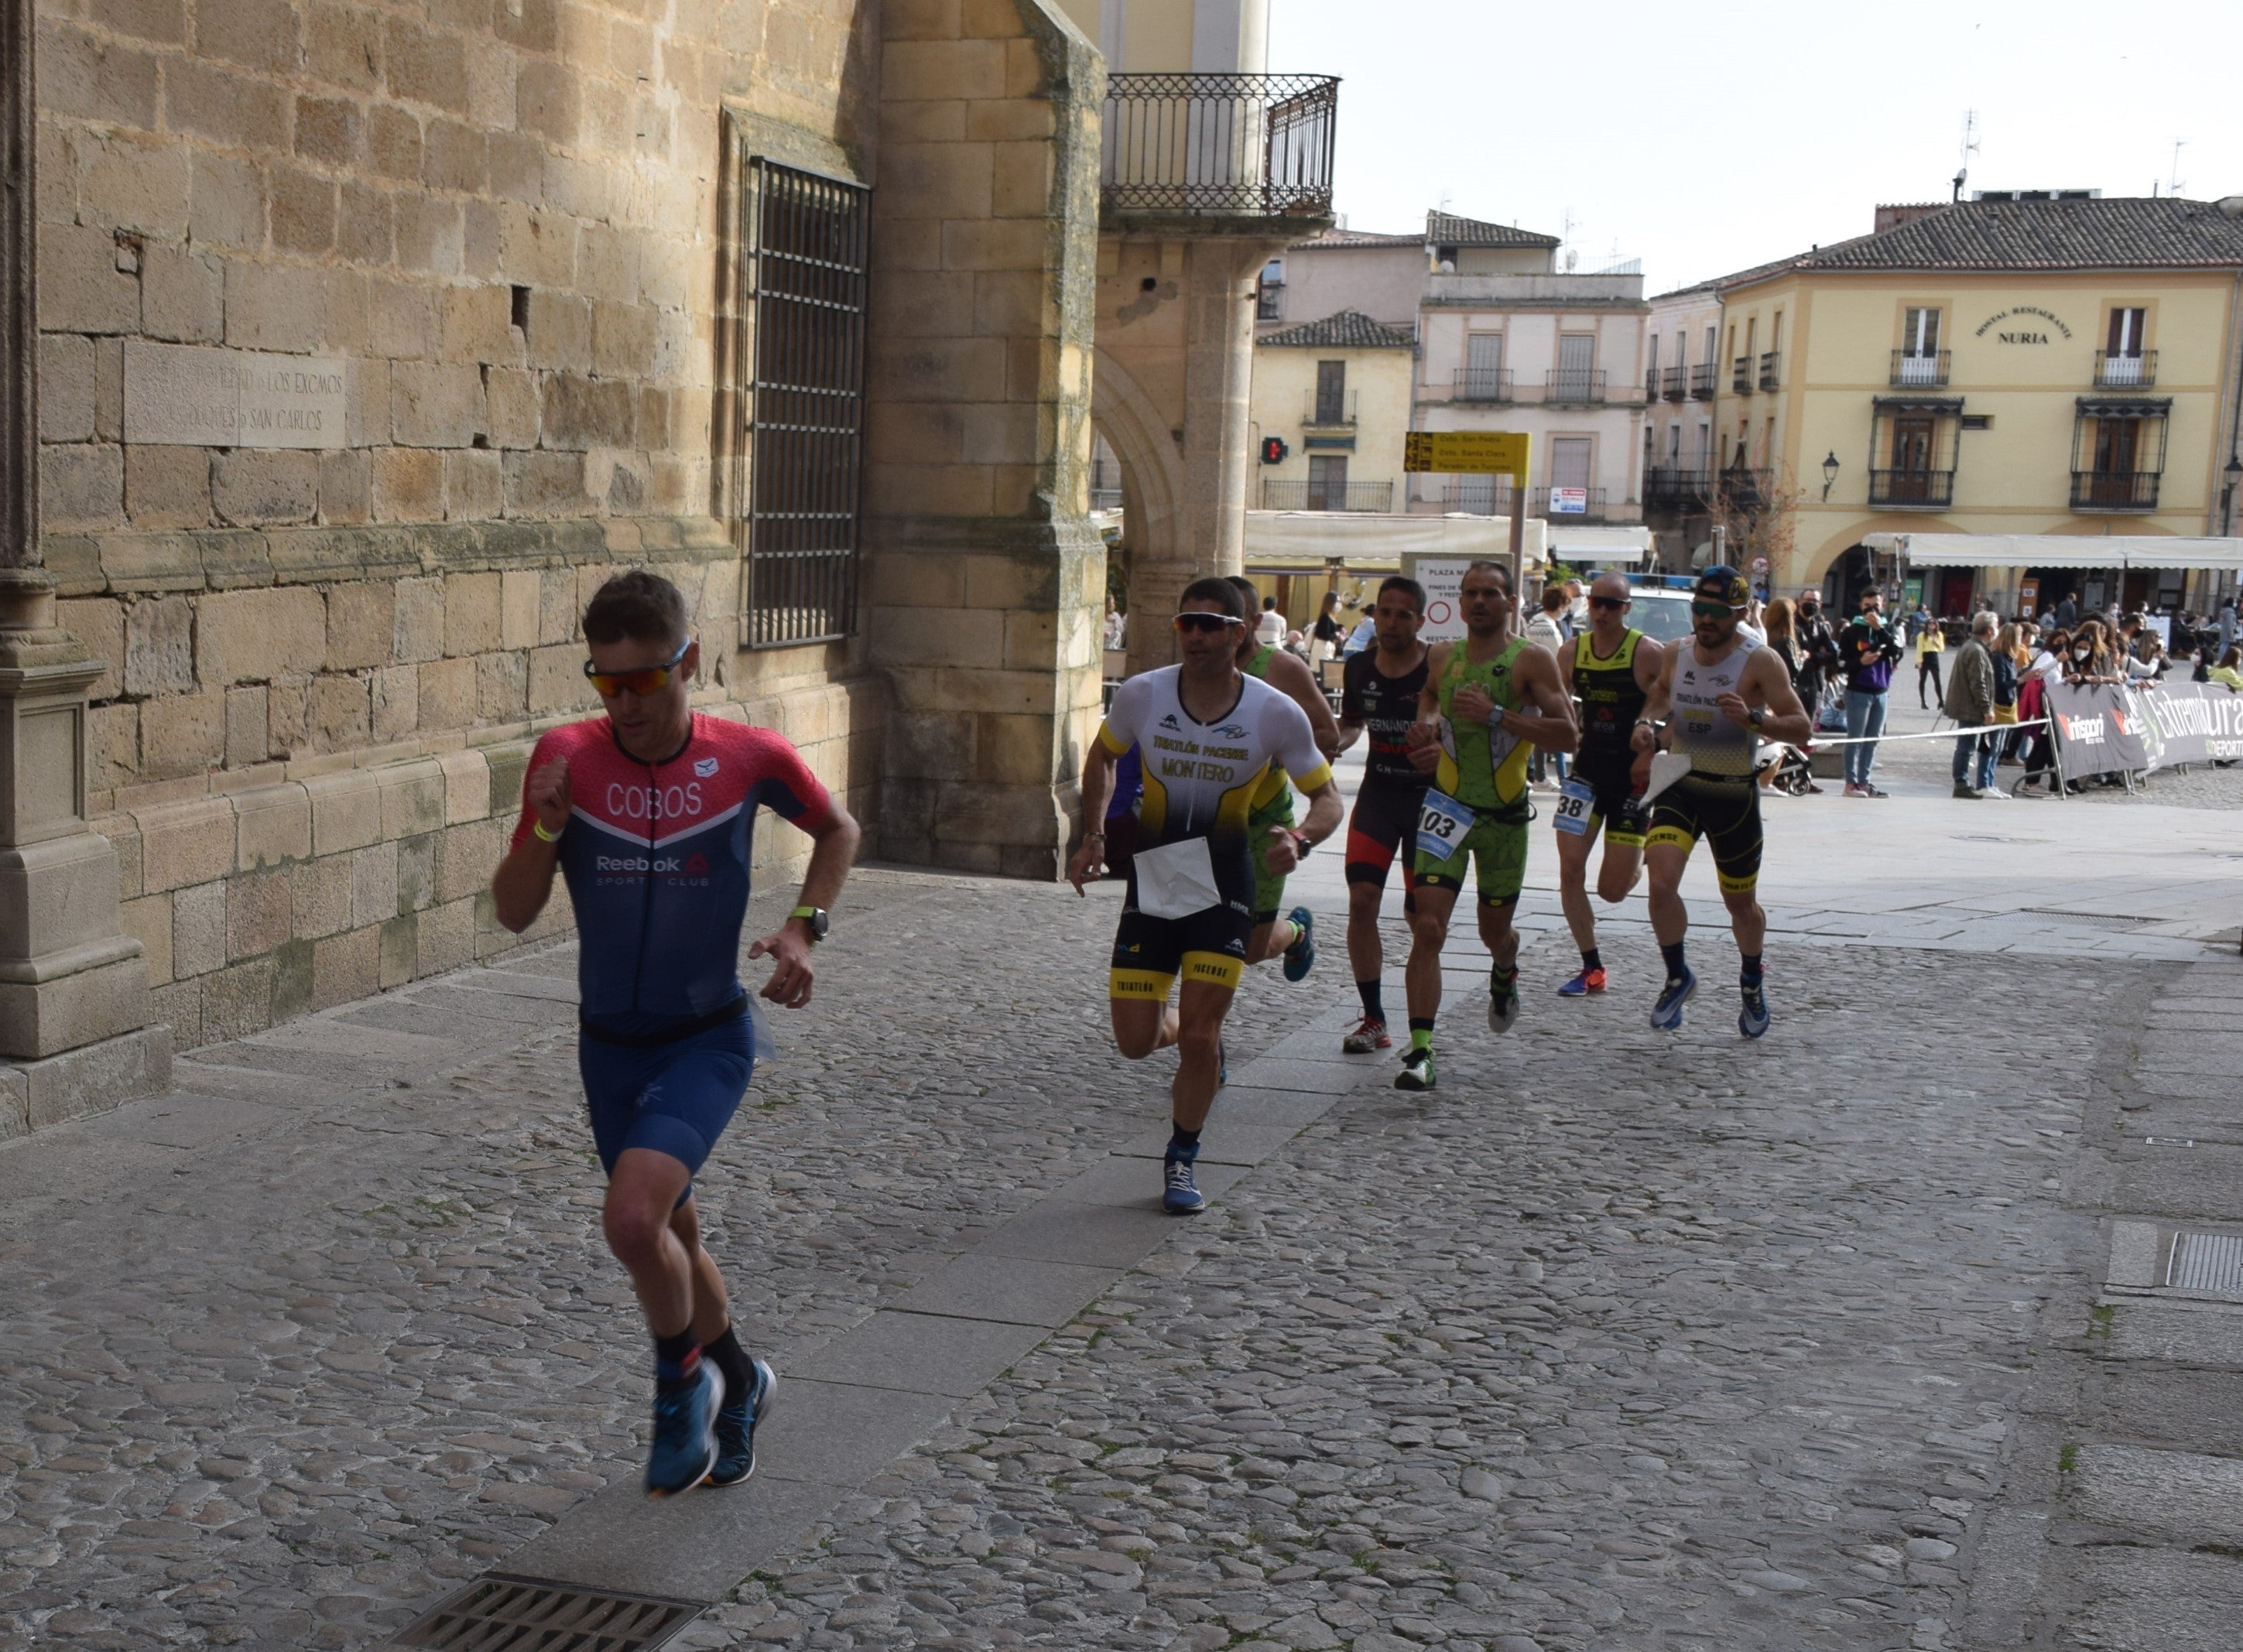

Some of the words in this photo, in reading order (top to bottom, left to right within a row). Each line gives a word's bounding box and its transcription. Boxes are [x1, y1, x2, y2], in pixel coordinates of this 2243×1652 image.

[1975, 311, 2008, 337] HOSTAL
[2012, 307, 2073, 340] RESTAURANTE
[1998, 333, 2048, 344] NURIA
[296, 372, 342, 395] EXCMOS
[249, 408, 272, 430] SAN
[277, 409, 322, 431] CARLOS
[1485, 450, 1505, 458] Clara
[1688, 723, 1711, 734] ESP
[1153, 735, 1200, 754] TRIATLÓN
[1202, 745, 1249, 761] PACENSE
[606, 782, 702, 820] COBOS
[1557, 796, 1584, 818] 38
[597, 856, 680, 872] Reebok
[597, 877, 646, 886] SPORT
[667, 877, 709, 887] CLUB
[1193, 963, 1228, 977] PACENSE
[1117, 980, 1153, 992] TRIATLÓN
